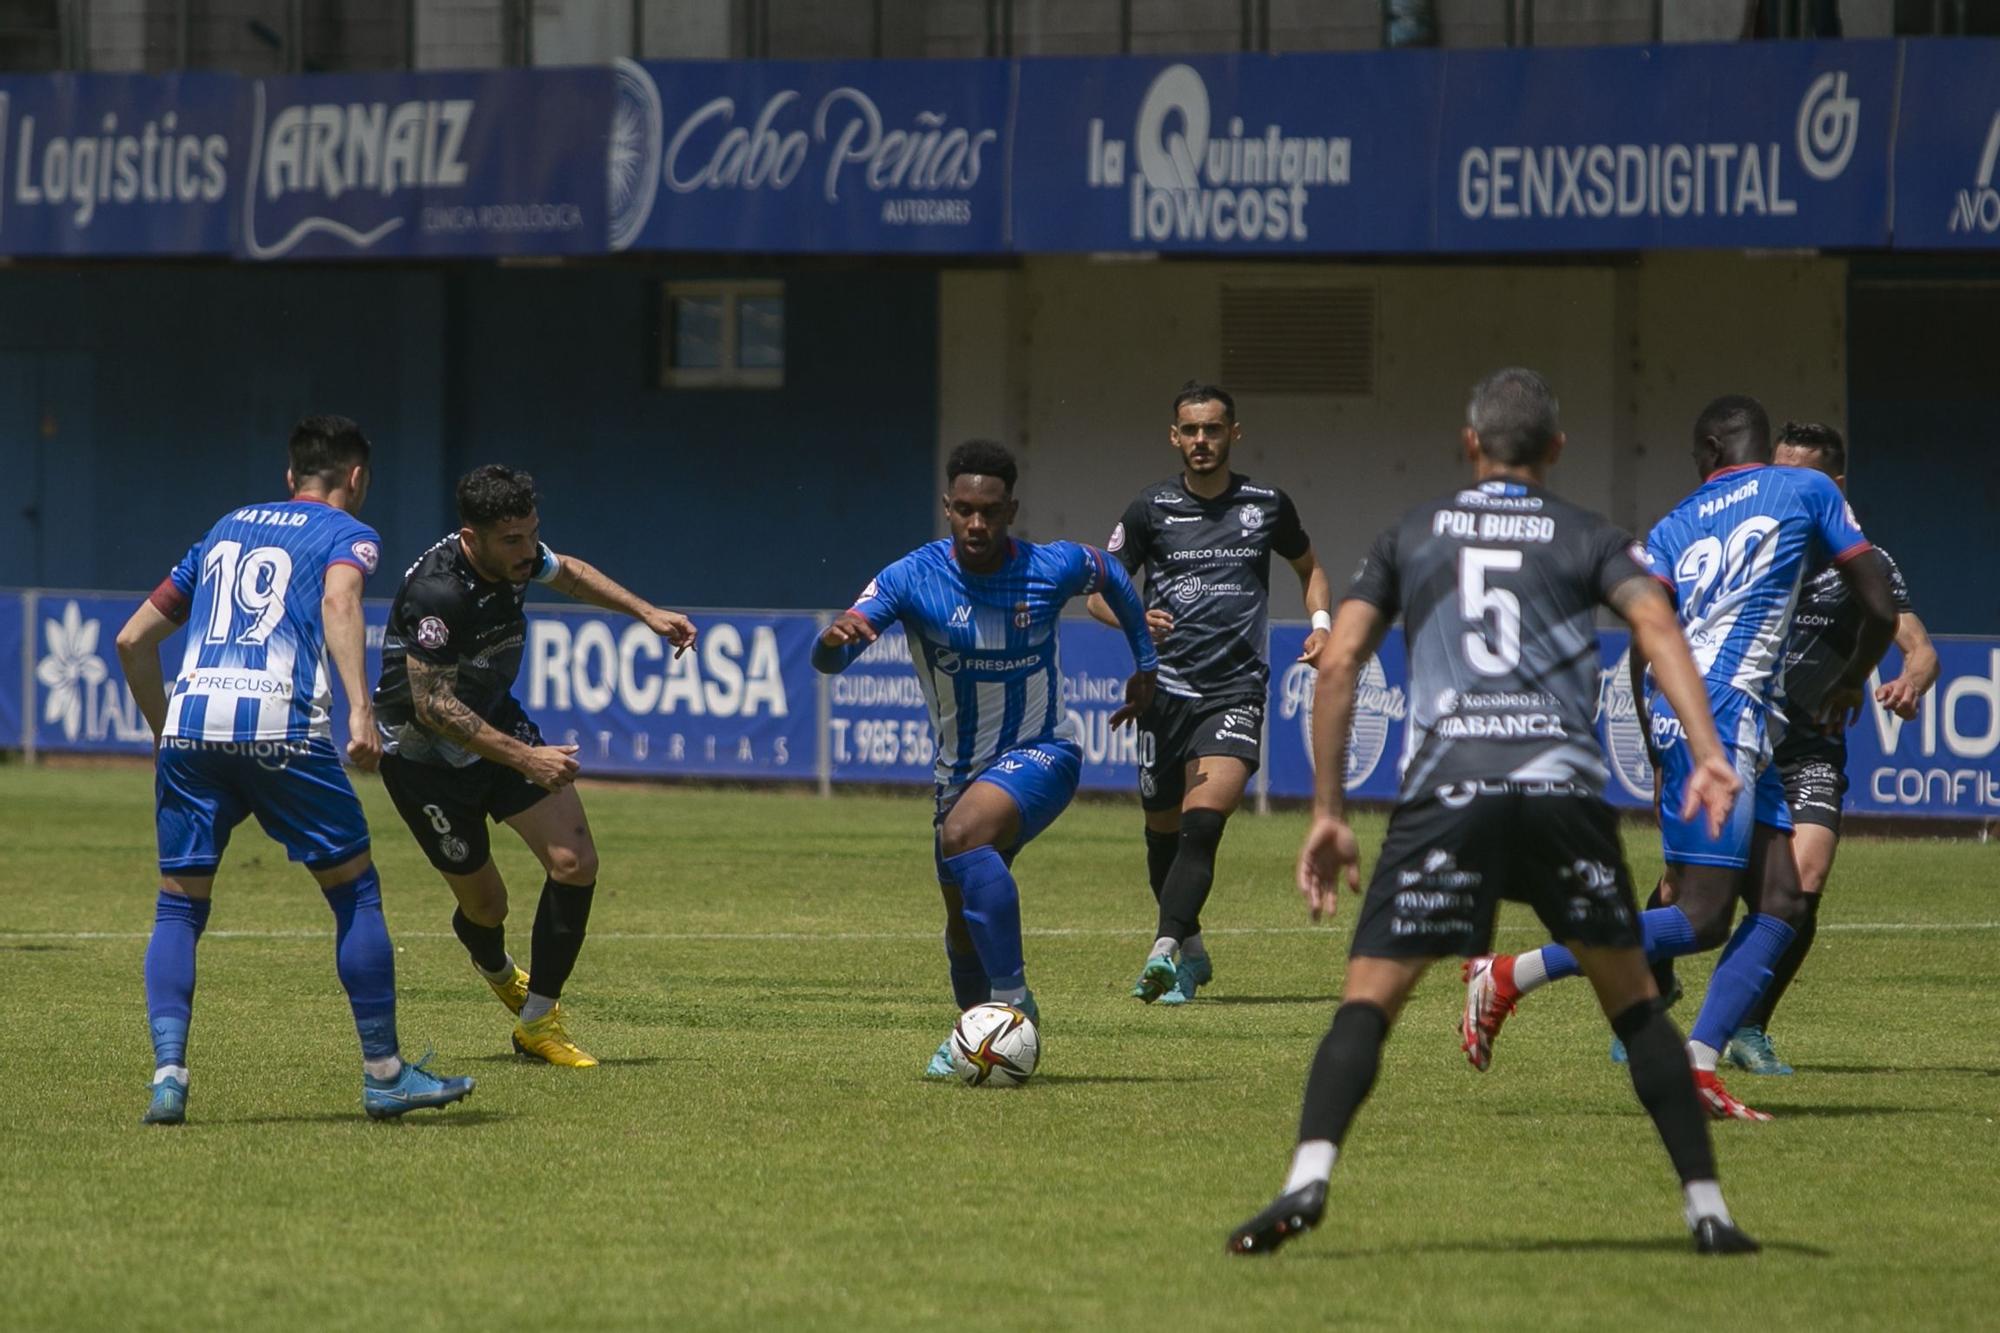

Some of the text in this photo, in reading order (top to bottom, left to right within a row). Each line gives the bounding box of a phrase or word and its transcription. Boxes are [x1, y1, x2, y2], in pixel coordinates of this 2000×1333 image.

[266, 100, 474, 197] ARNAIZ
[665, 87, 997, 203] Cabo Peñas
[1088, 63, 1352, 190] la Quintana
[16, 111, 228, 229] Logistics
[1130, 173, 1309, 241] lowcost
[1458, 143, 1798, 219] GENXSDIGITAL
[234, 509, 308, 527] NATALIO
[1173, 549, 1213, 561] ORECO
[1433, 509, 1555, 543] POL BUESO
[202, 540, 293, 646] 19
[1676, 515, 1779, 621] 20
[1459, 547, 1523, 677] 5
[197, 677, 285, 695] PRECUSA
[529, 619, 789, 718] ROCASA
[563, 728, 790, 768] STURIAS
[422, 804, 452, 834] 8
